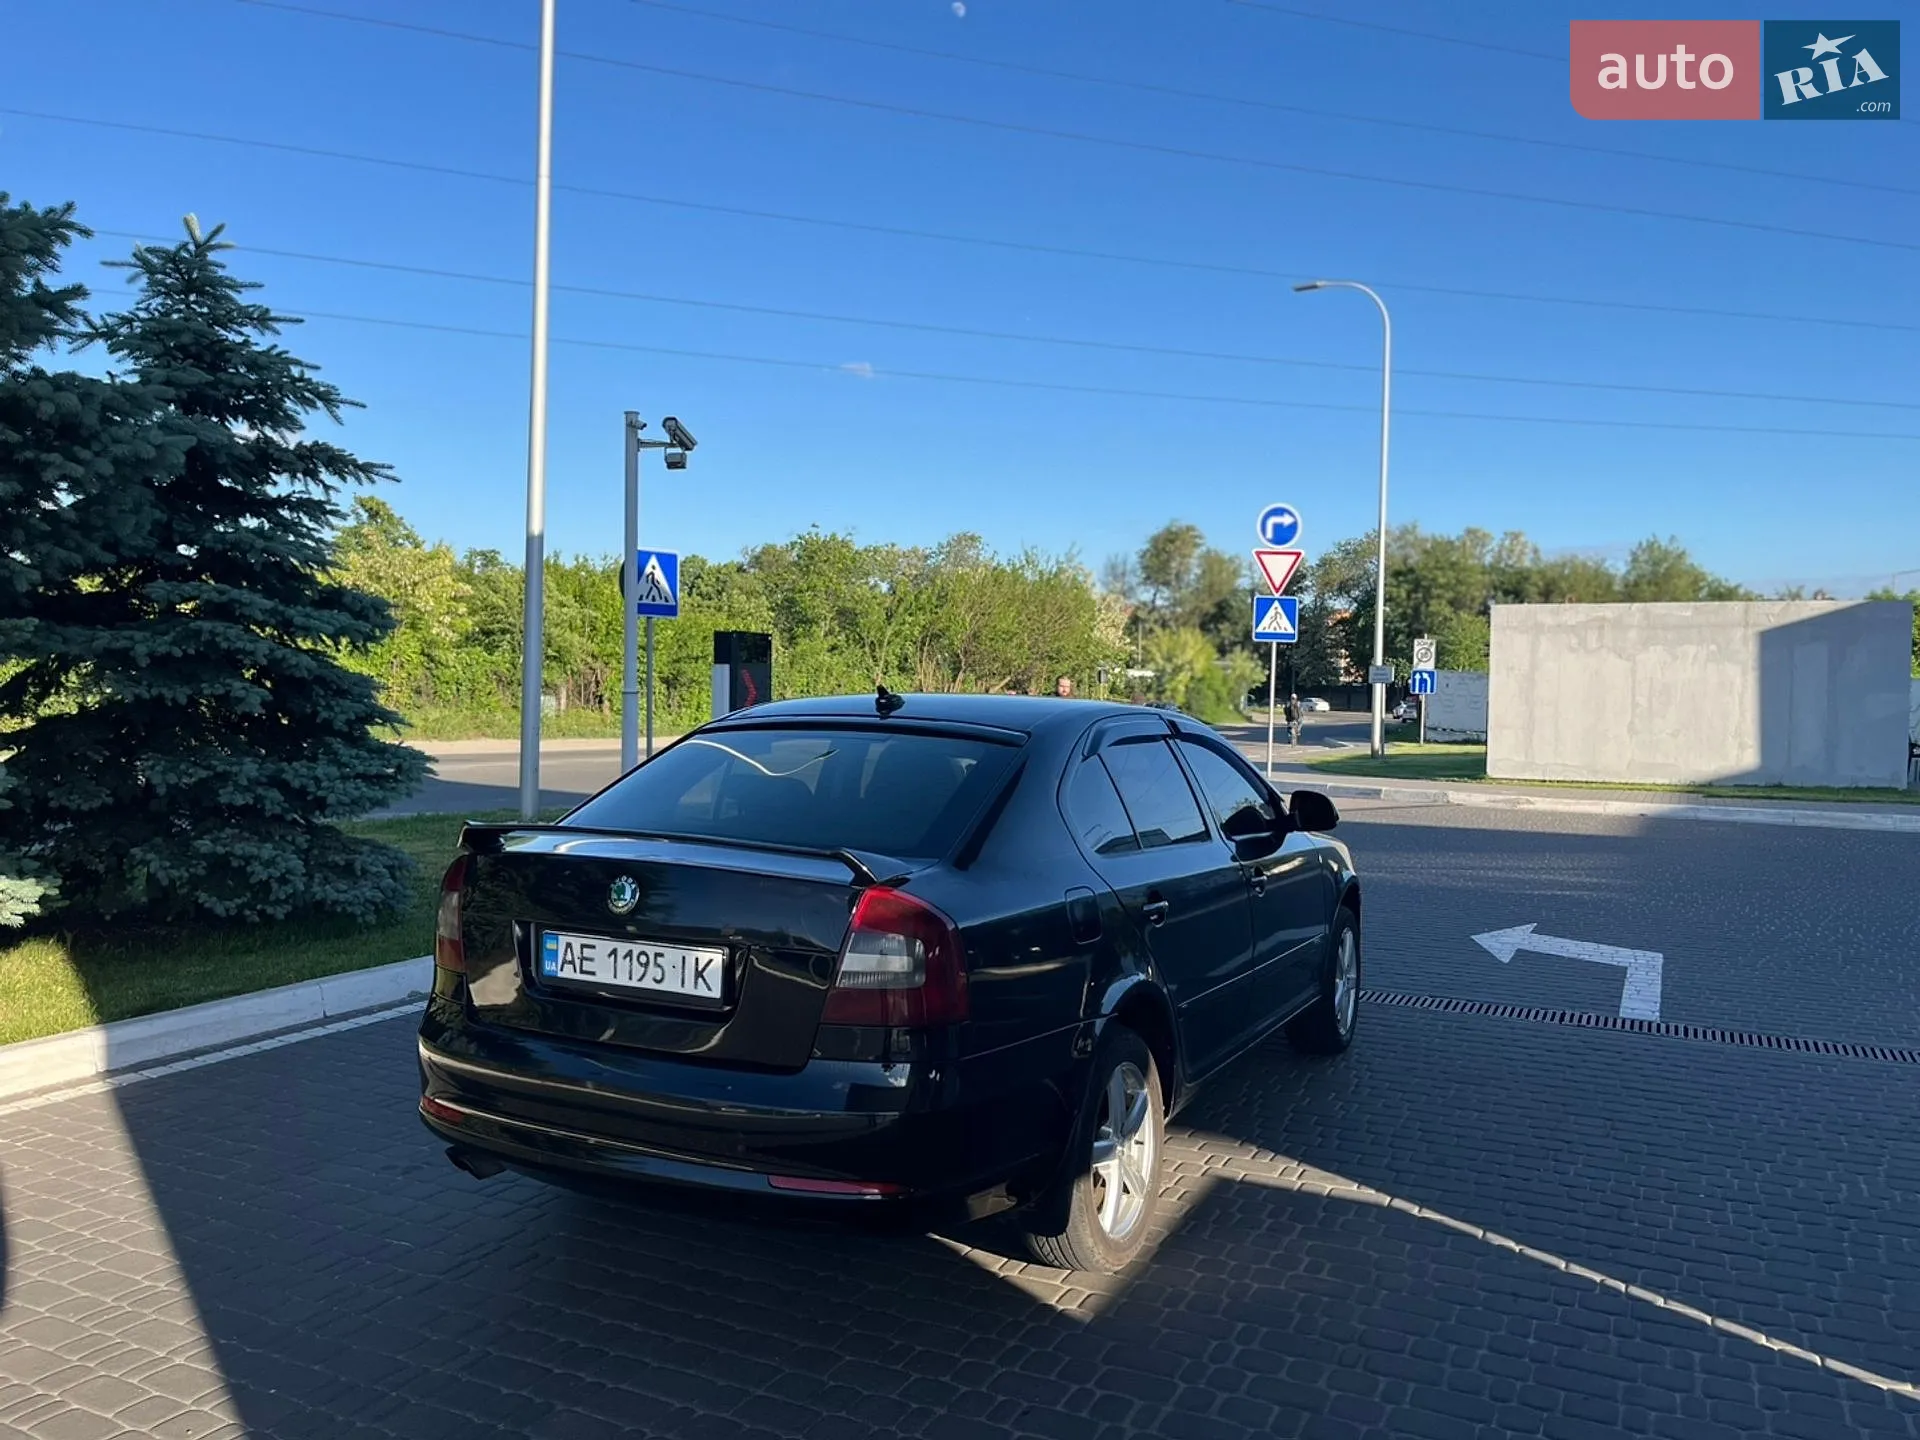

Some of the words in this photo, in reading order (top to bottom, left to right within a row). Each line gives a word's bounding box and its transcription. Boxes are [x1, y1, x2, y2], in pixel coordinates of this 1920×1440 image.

[545, 959, 557, 971] UA
[560, 942, 597, 976] AE
[607, 947, 665, 984] 1195
[681, 955, 714, 992] IK
